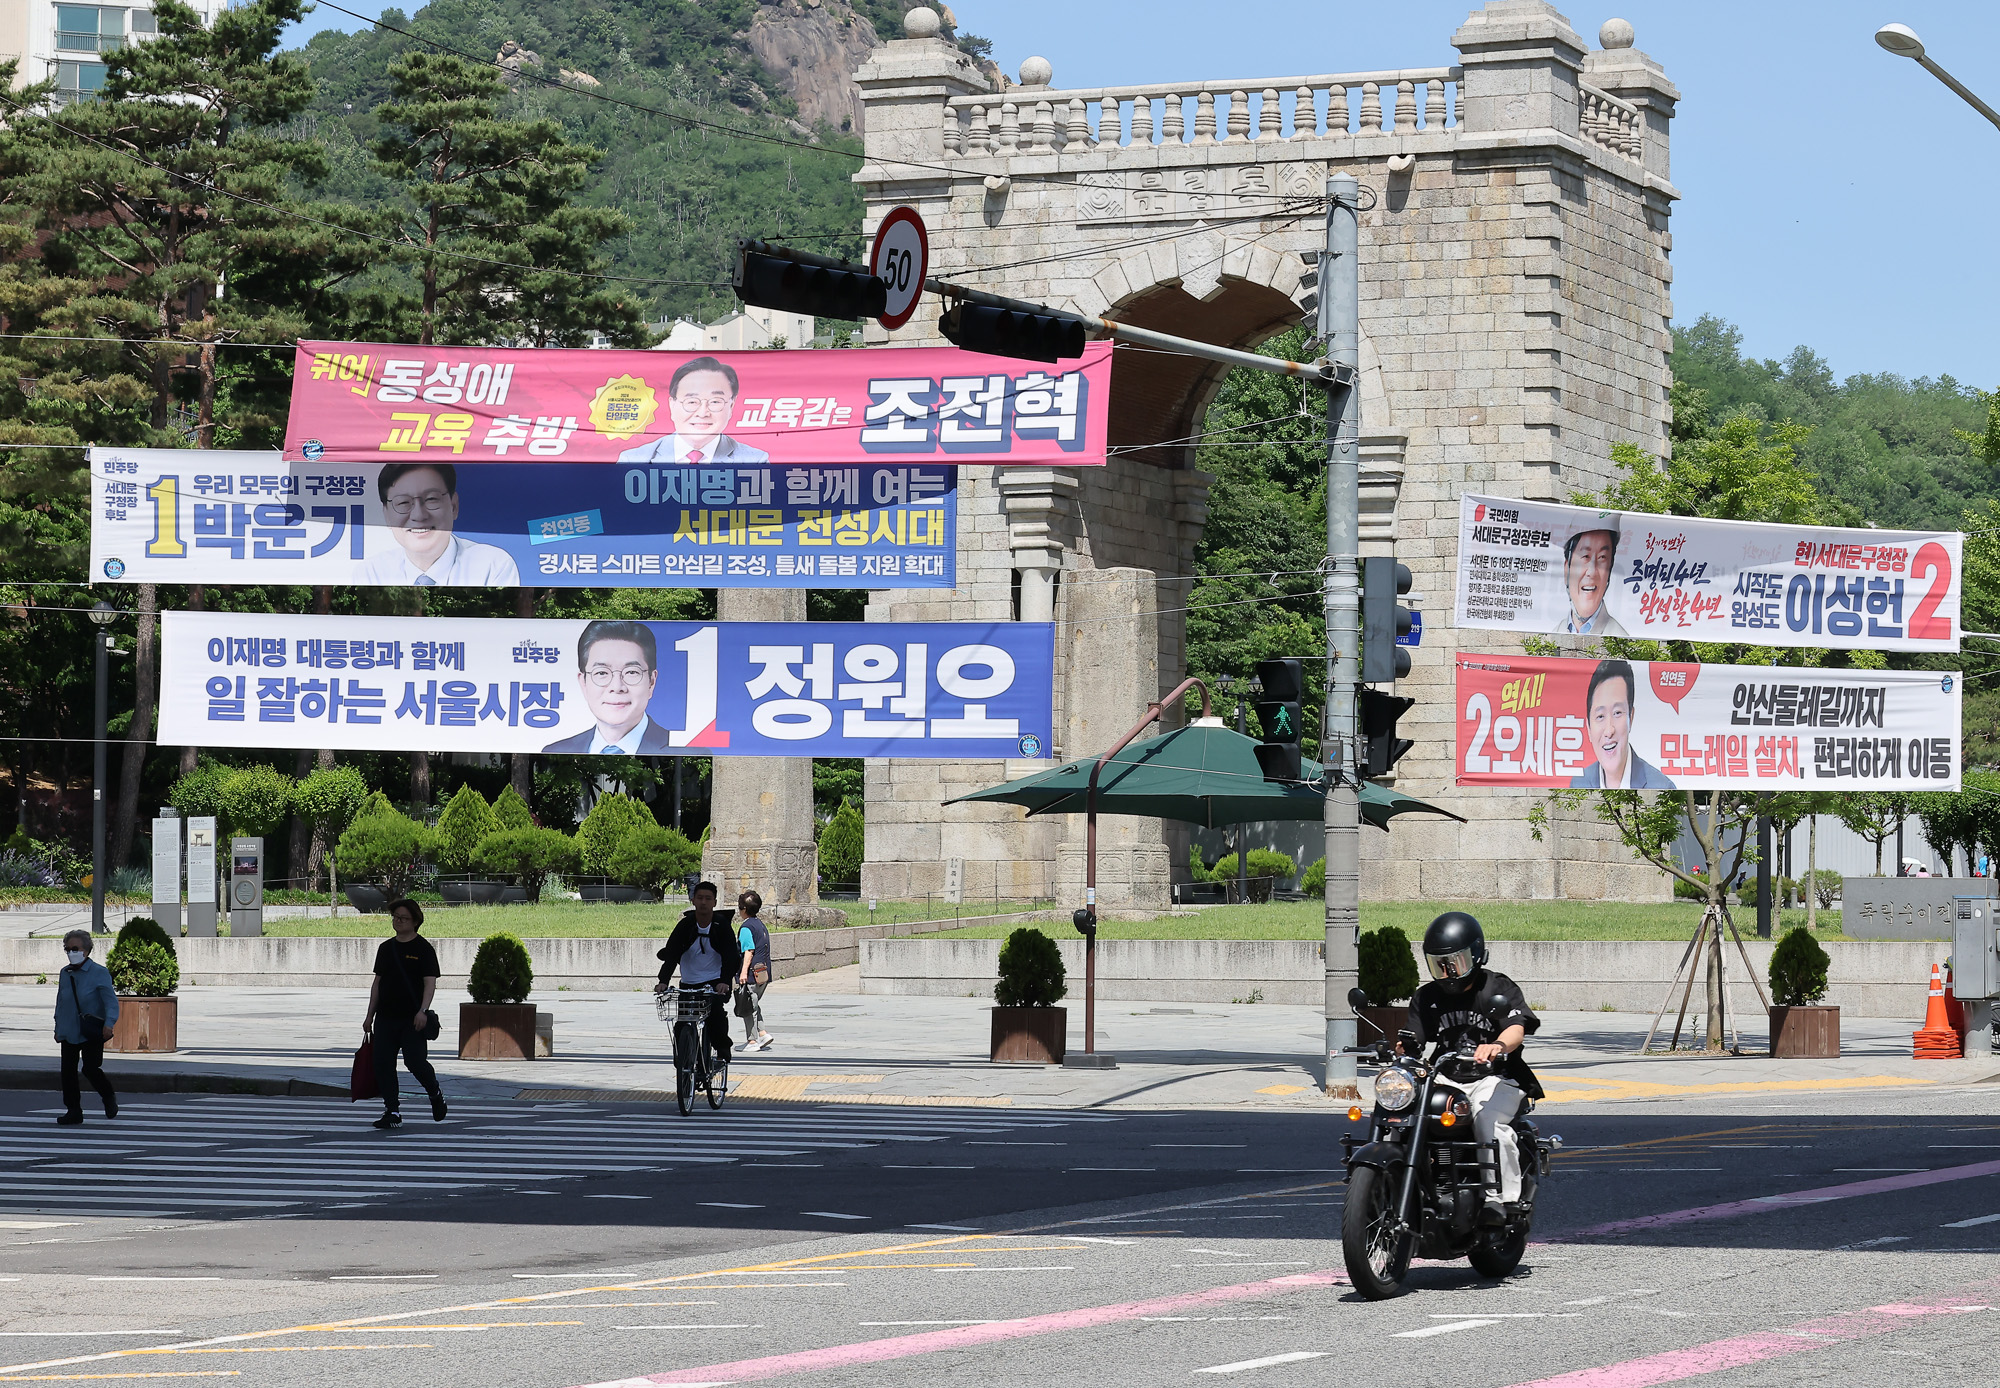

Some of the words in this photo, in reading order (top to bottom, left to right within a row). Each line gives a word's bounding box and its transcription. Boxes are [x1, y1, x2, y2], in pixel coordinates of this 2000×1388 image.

[884, 248, 912, 292] 50
[310, 353, 369, 382] 퀴어
[377, 359, 515, 406] 동성애
[606, 412, 638, 420] 단일후보
[608, 403, 639, 412] 중도보수
[734, 396, 853, 428] 교육감은
[860, 371, 1088, 453] 조전혁
[378, 412, 475, 454] 교육
[482, 413, 579, 456] 추방
[104, 462, 138, 474] 민주당
[194, 475, 233, 495] 우리
[239, 475, 300, 496] 모두의
[305, 475, 366, 496] 구청장
[105, 483, 137, 494] 서대문
[105, 497, 138, 508] 구청장
[624, 468, 775, 506] 이재명과
[786, 468, 859, 506] 함께
[872, 469, 945, 505] 여는
[105, 509, 127, 521] 후보
[145, 474, 188, 559] 1
[194, 504, 365, 560] 박운기
[540, 514, 591, 539] 천연동
[672, 510, 784, 546] 서대문
[797, 509, 945, 546] 전성시대
[1488, 508, 1519, 524] 국민의힘
[1472, 526, 1551, 548] 서대문구청장후보
[538, 553, 598, 574] 경사로
[601, 554, 660, 574] 스마트
[664, 554, 724, 575] 안심길
[728, 554, 771, 577] 조성,
[776, 554, 814, 576] 틈새
[819, 554, 858, 576] 돌봄
[862, 554, 900, 576] 지원
[904, 555, 944, 576] 확대
[1470, 554, 1490, 568] 서대문
[1733, 572, 1784, 599] 시작도
[1908, 542, 1952, 640] 2
[1731, 602, 1780, 629] 완성도
[1786, 574, 1904, 638] 이성헌
[207, 636, 286, 668] 이재명
[296, 639, 404, 670] 대통령과
[411, 641, 466, 671] 함께
[512, 647, 560, 664] 민주당
[668, 626, 731, 747] 1
[744, 642, 1020, 740] 정원오
[1500, 673, 1546, 714] 역시!
[1660, 670, 1687, 687] 천연동
[206, 676, 246, 722] 일
[256, 676, 386, 724] 잘하는
[395, 681, 565, 728] 서울시장
[1731, 683, 1886, 728] 안산둘레길까지
[1464, 692, 1492, 773] 2
[1492, 714, 1584, 776] 오세훈
[1660, 734, 1749, 778] 모노레일
[1755, 736, 1804, 779] 설치,
[1814, 737, 1902, 778] 편리하게
[1908, 738, 1952, 778] 이동
